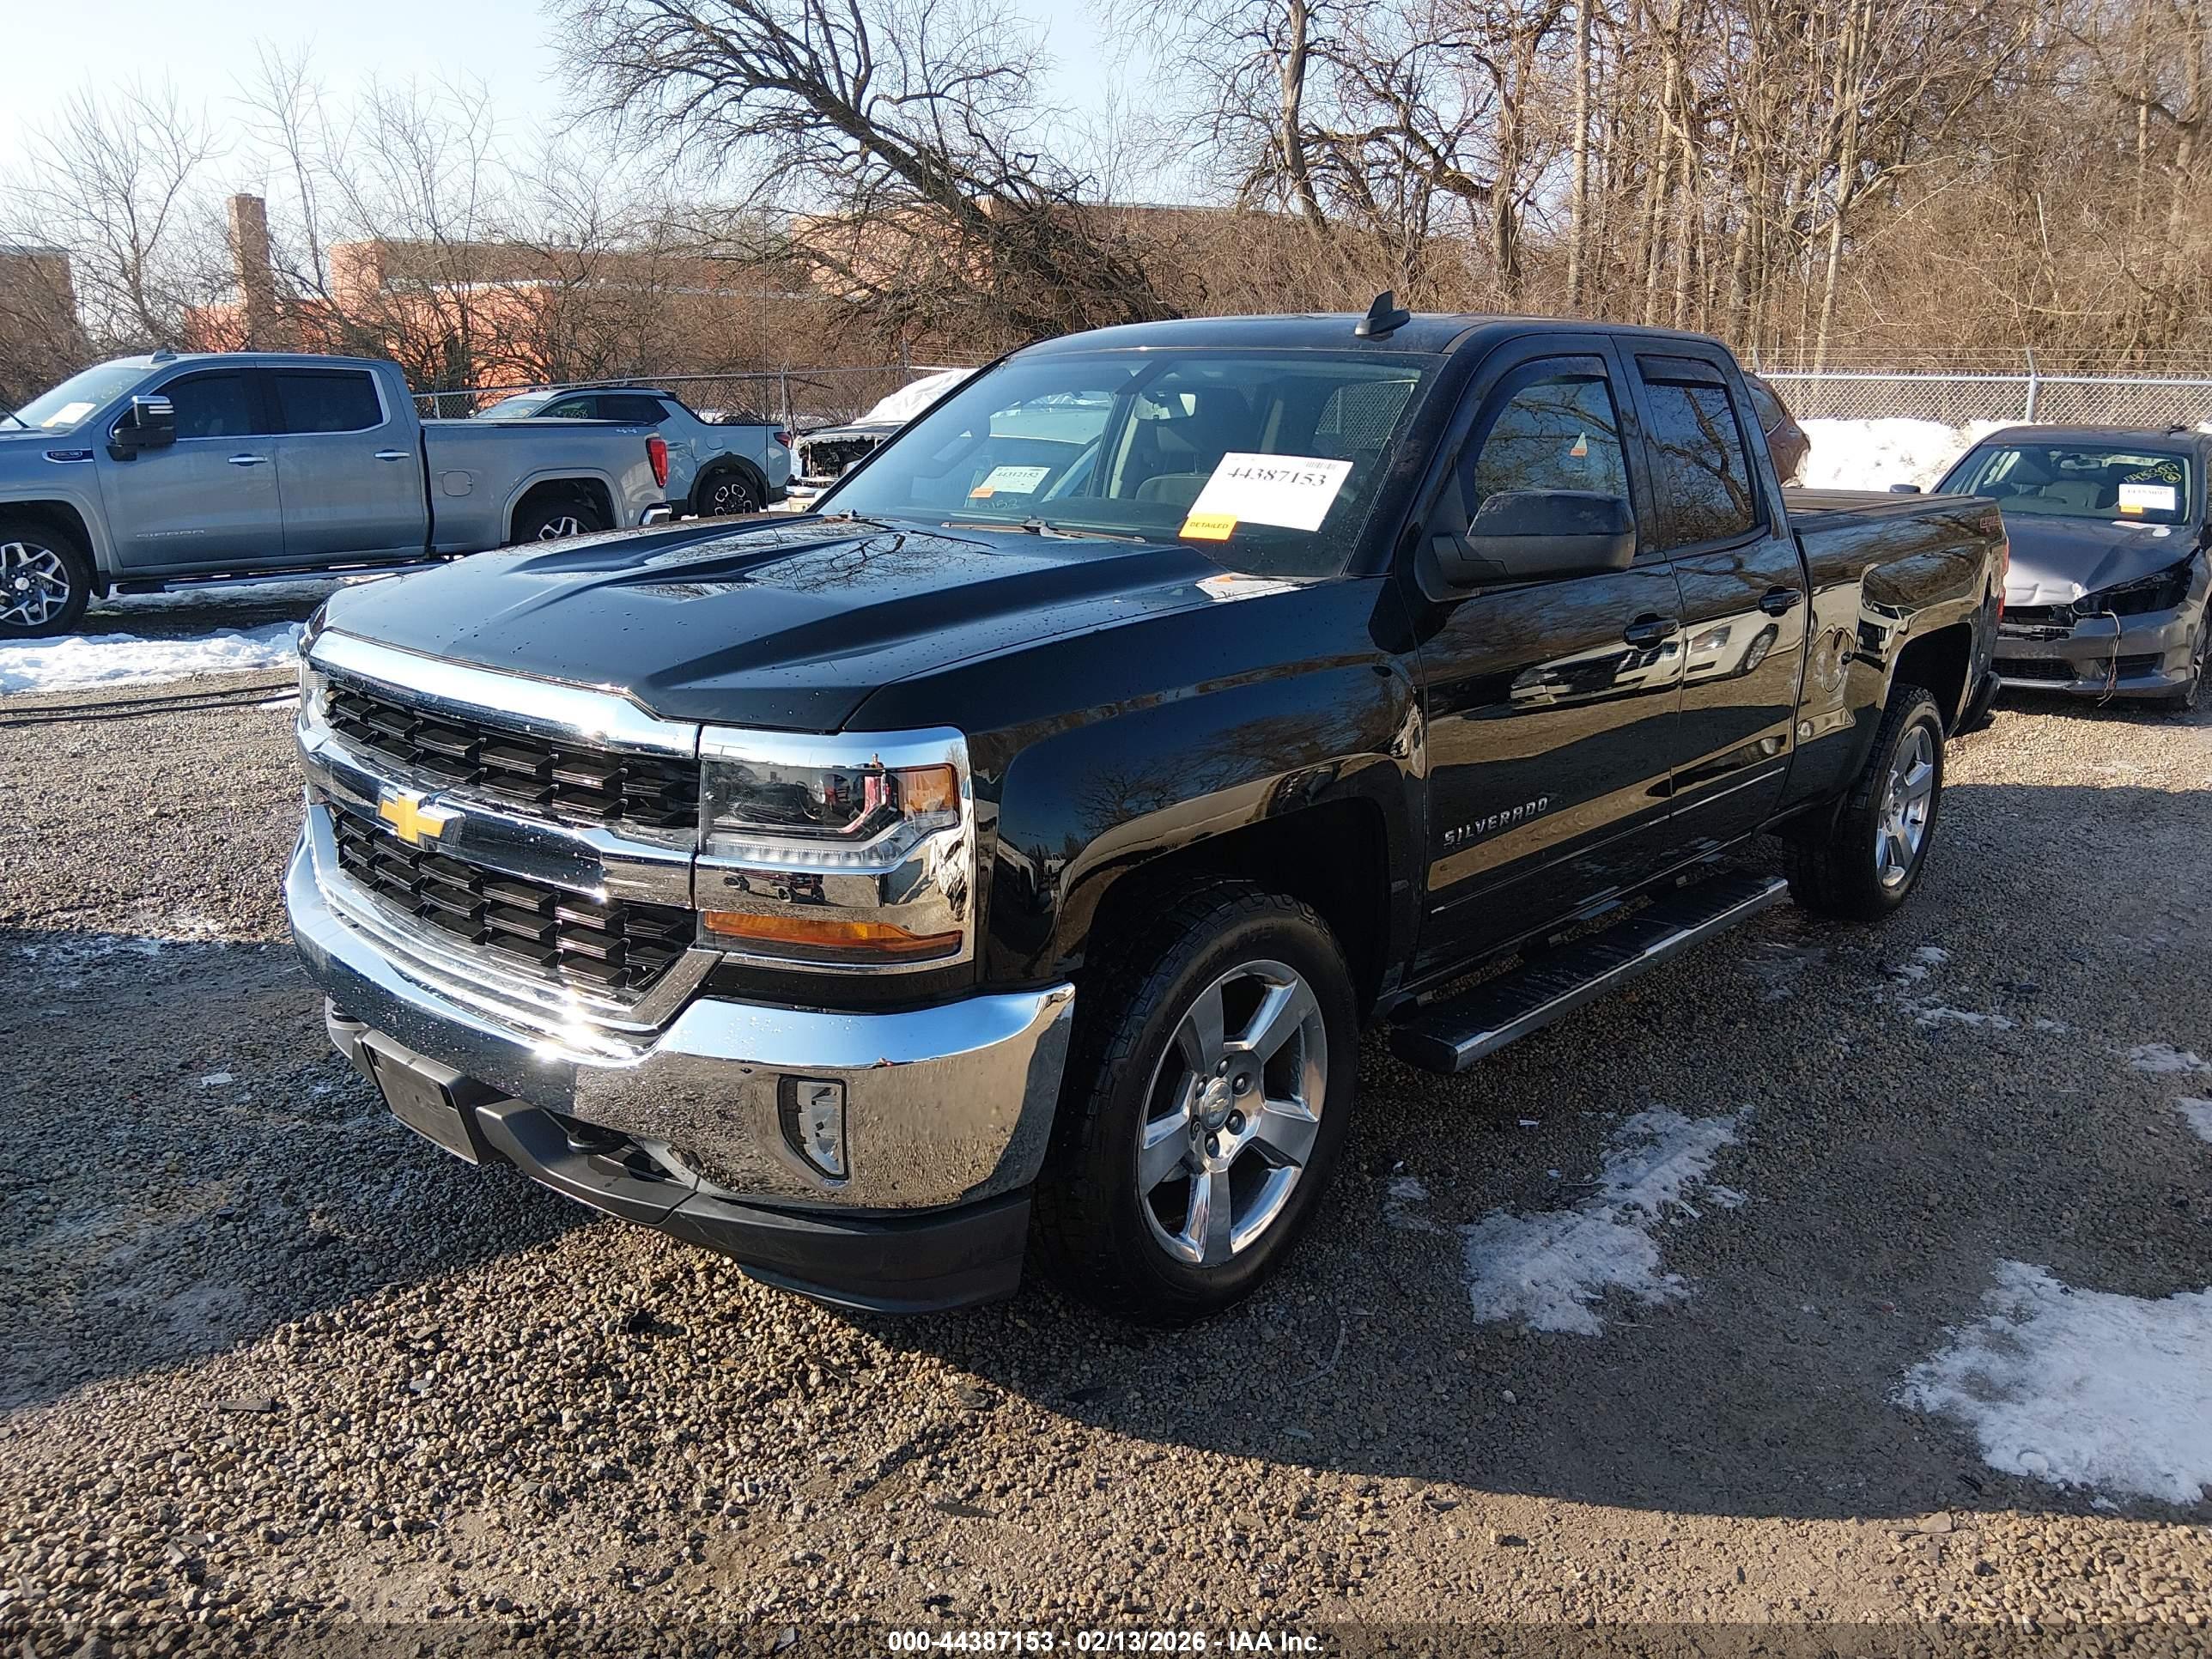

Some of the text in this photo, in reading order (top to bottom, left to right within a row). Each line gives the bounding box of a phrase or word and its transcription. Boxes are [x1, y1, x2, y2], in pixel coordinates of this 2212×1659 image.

[1227, 465, 1328, 488] 44387153
[1189, 520, 1230, 530] DETAILED
[1443, 797, 1548, 845] SILVERADO
